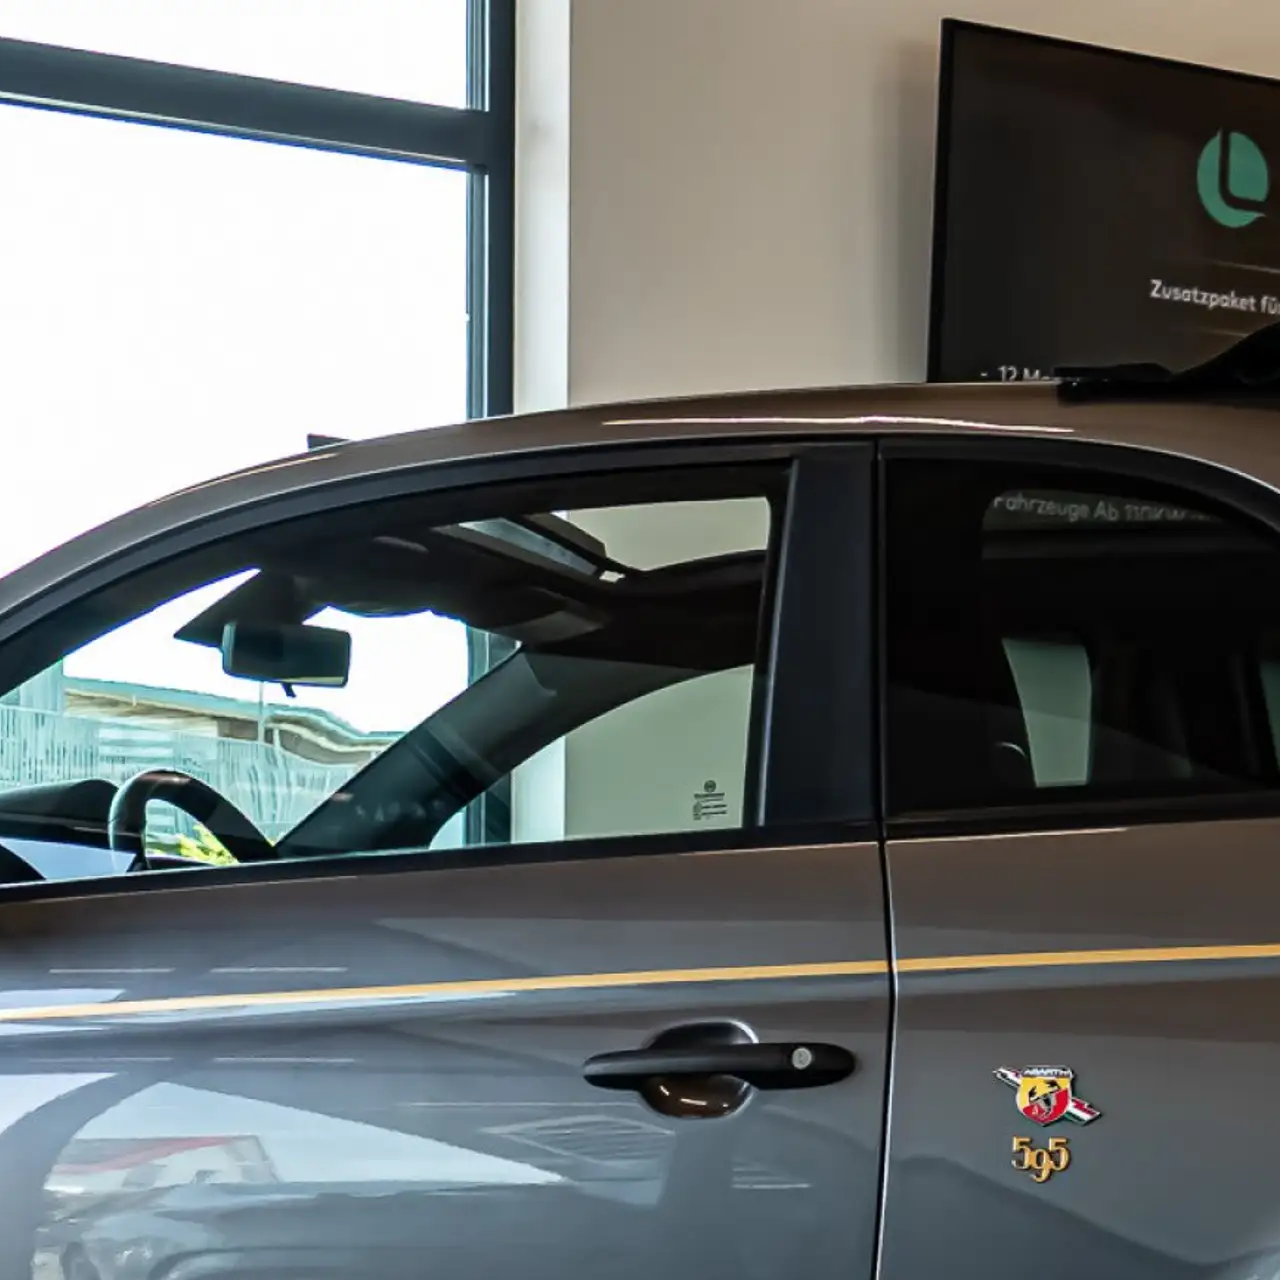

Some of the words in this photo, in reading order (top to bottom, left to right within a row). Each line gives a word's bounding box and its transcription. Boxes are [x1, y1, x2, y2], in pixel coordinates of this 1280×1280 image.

[1150, 279, 1257, 313] Zusatzpaket
[1093, 501, 1120, 521] Ab
[1011, 1136, 1071, 1183] 595
